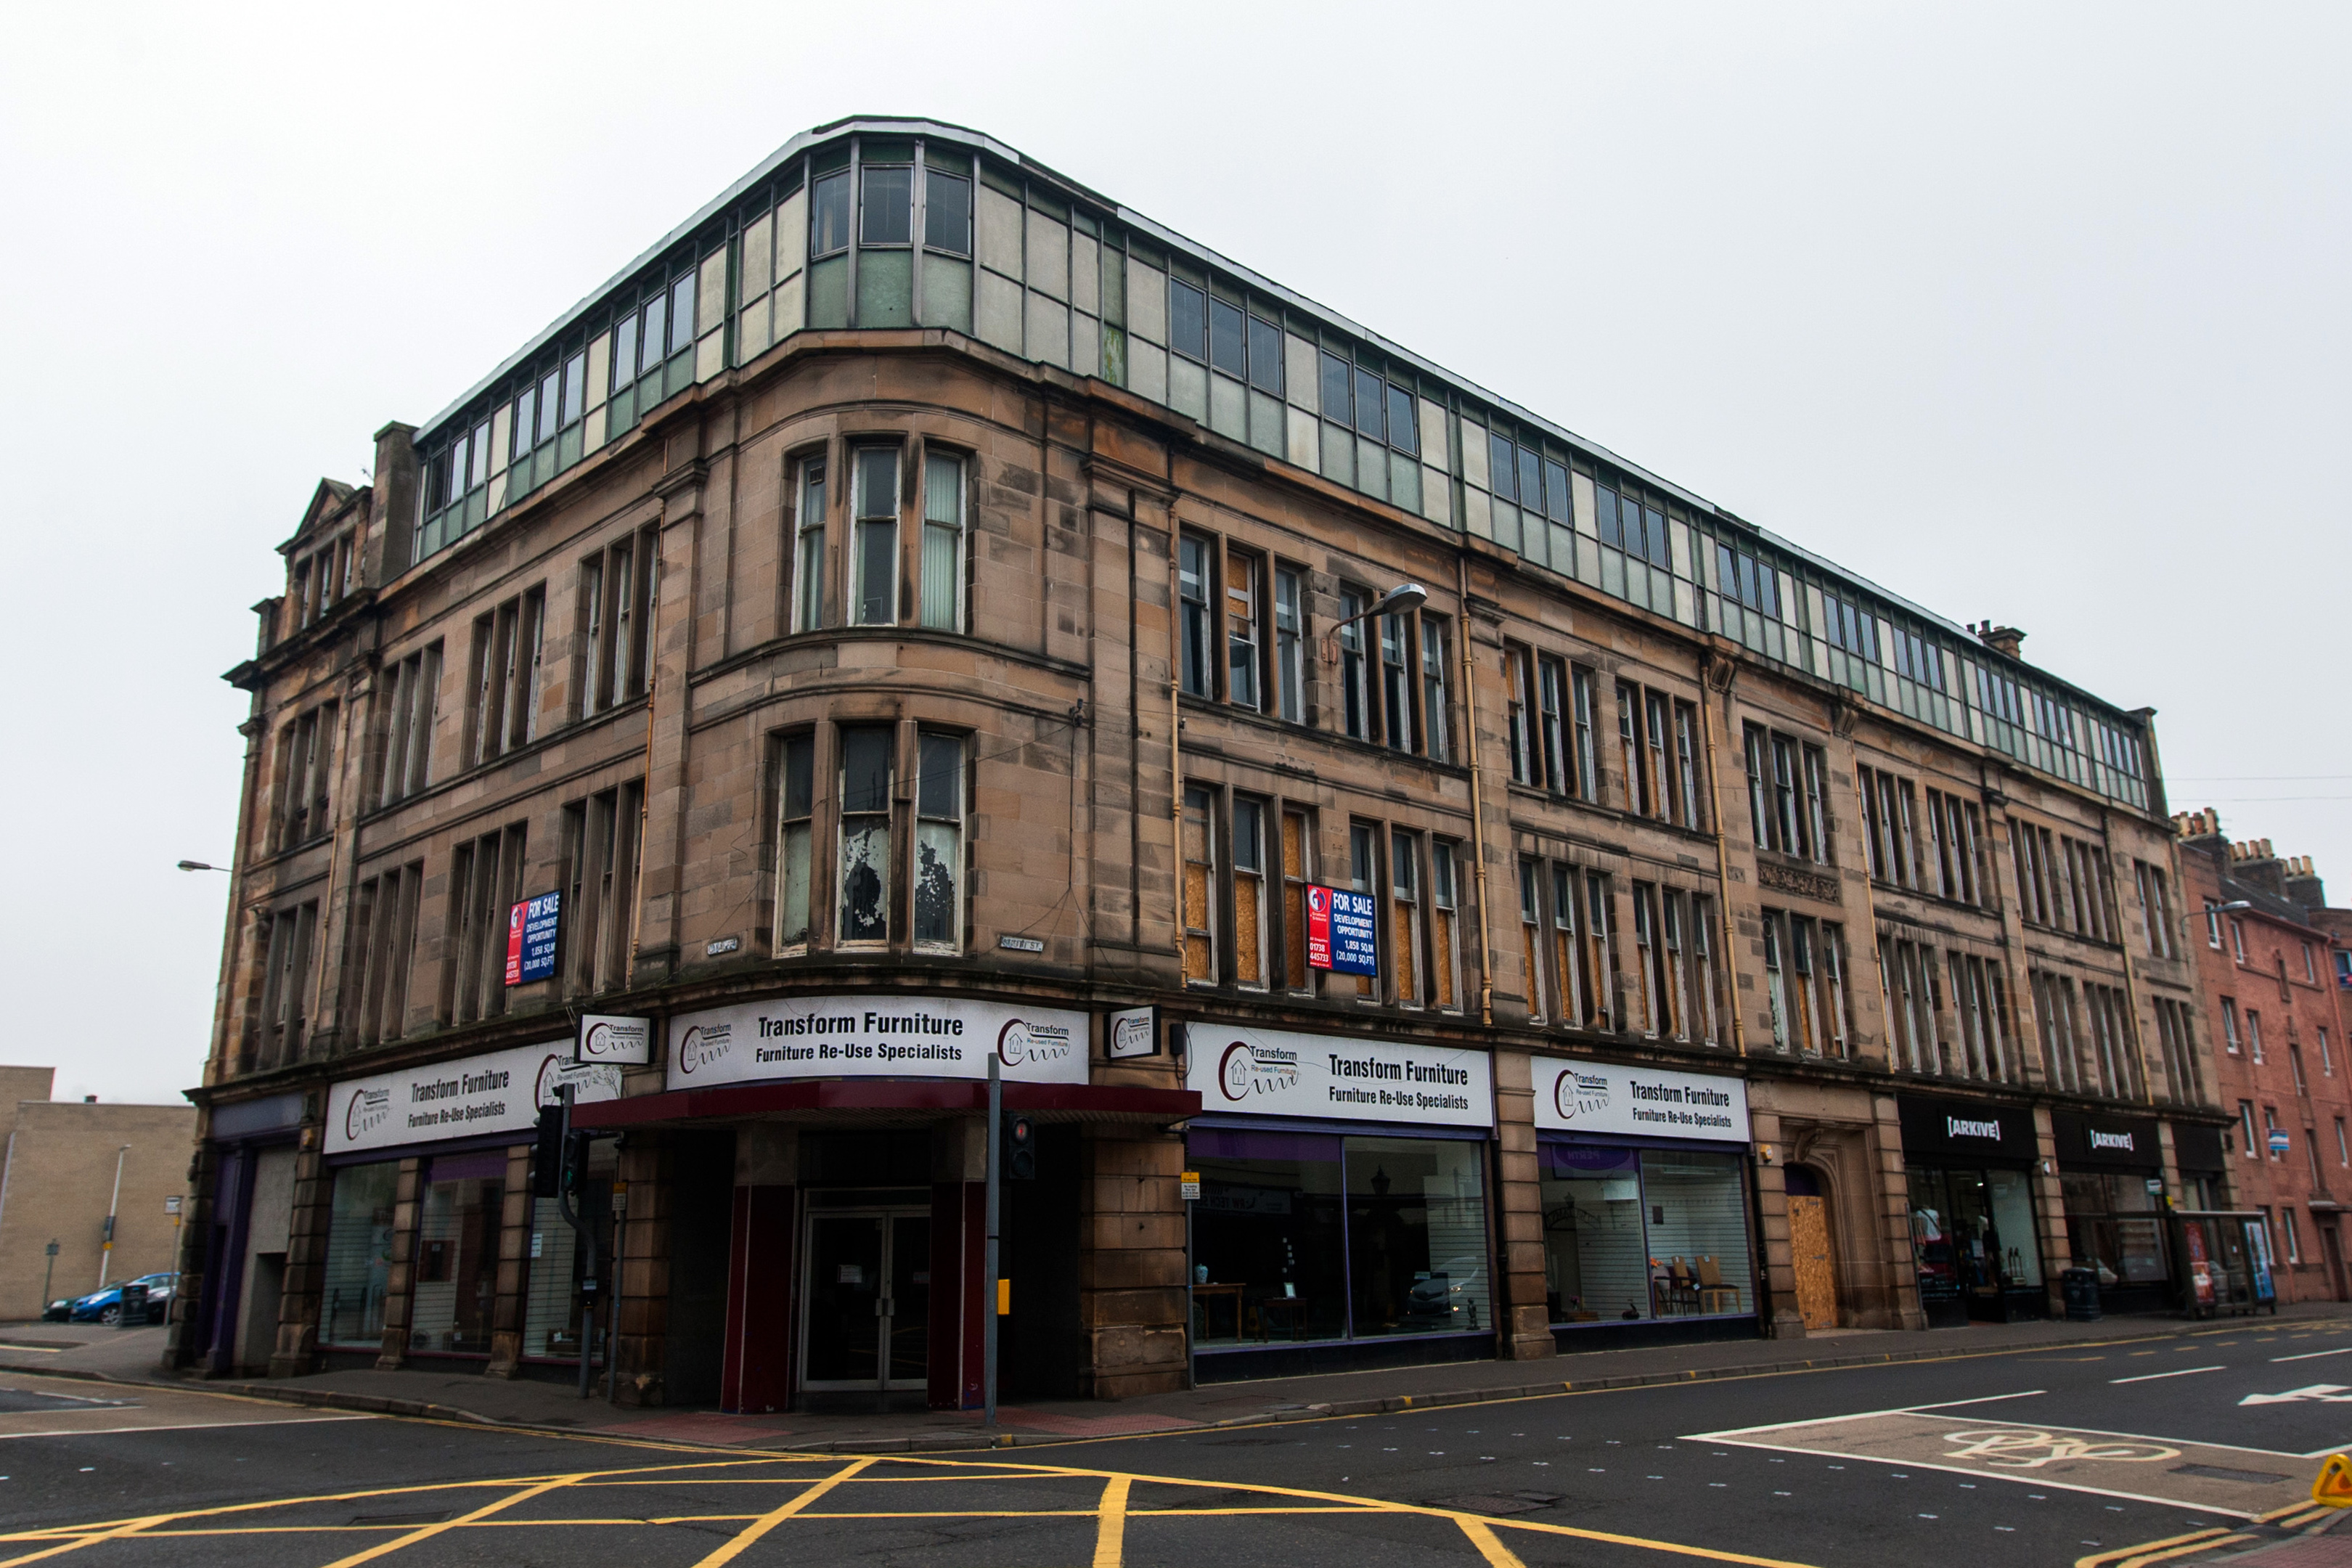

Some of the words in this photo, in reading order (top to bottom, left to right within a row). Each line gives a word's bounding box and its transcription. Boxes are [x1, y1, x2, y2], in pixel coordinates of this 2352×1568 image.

[528, 900, 542, 919] FOR
[542, 894, 559, 915] SALE
[1333, 892, 1350, 911] FOR
[1352, 897, 1373, 915] SALE
[526, 916, 558, 933] DEVELOPMENT
[1334, 913, 1372, 928] DEVELOPMENT
[527, 928, 556, 944] OPPORTUNITY
[1337, 926, 1373, 939] OPPORTUNITY
[1310, 942, 1326, 952] 01738
[1344, 940, 1359, 950] 1,858
[1310, 952, 1329, 963] 445733
[1336, 950, 1357, 963] (20,000
[701, 1024, 731, 1035] Transform
[759, 1013, 856, 1037] Transform
[864, 1012, 963, 1036] Furniture
[1026, 1022, 1069, 1036] Transform
[756, 1045, 814, 1063] Furniture
[819, 1043, 873, 1059] Re-Use
[878, 1043, 962, 1061] Specialists
[1250, 1045, 1297, 1061] Transform
[1328, 1054, 1402, 1080] Transform
[1406, 1061, 1468, 1086] Furniture
[412, 1078, 459, 1103] Transform
[462, 1069, 510, 1095] Furniture
[1574, 1073, 1607, 1086] Transform
[364, 1088, 390, 1100] Transform
[1329, 1086, 1376, 1104] Furniture
[1379, 1090, 1413, 1106] Re-Use
[1416, 1092, 1469, 1110] Specialists
[1630, 1080, 1683, 1103] Transform
[1685, 1086, 1729, 1107] Furniture
[408, 1111, 438, 1128] Furniture
[440, 1107, 464, 1124] Re-Use
[465, 1101, 506, 1123] Specialists
[1633, 1107, 1667, 1123] Furniture
[1668, 1110, 1693, 1124] Re-Use
[1694, 1112, 1732, 1128] Specialists
